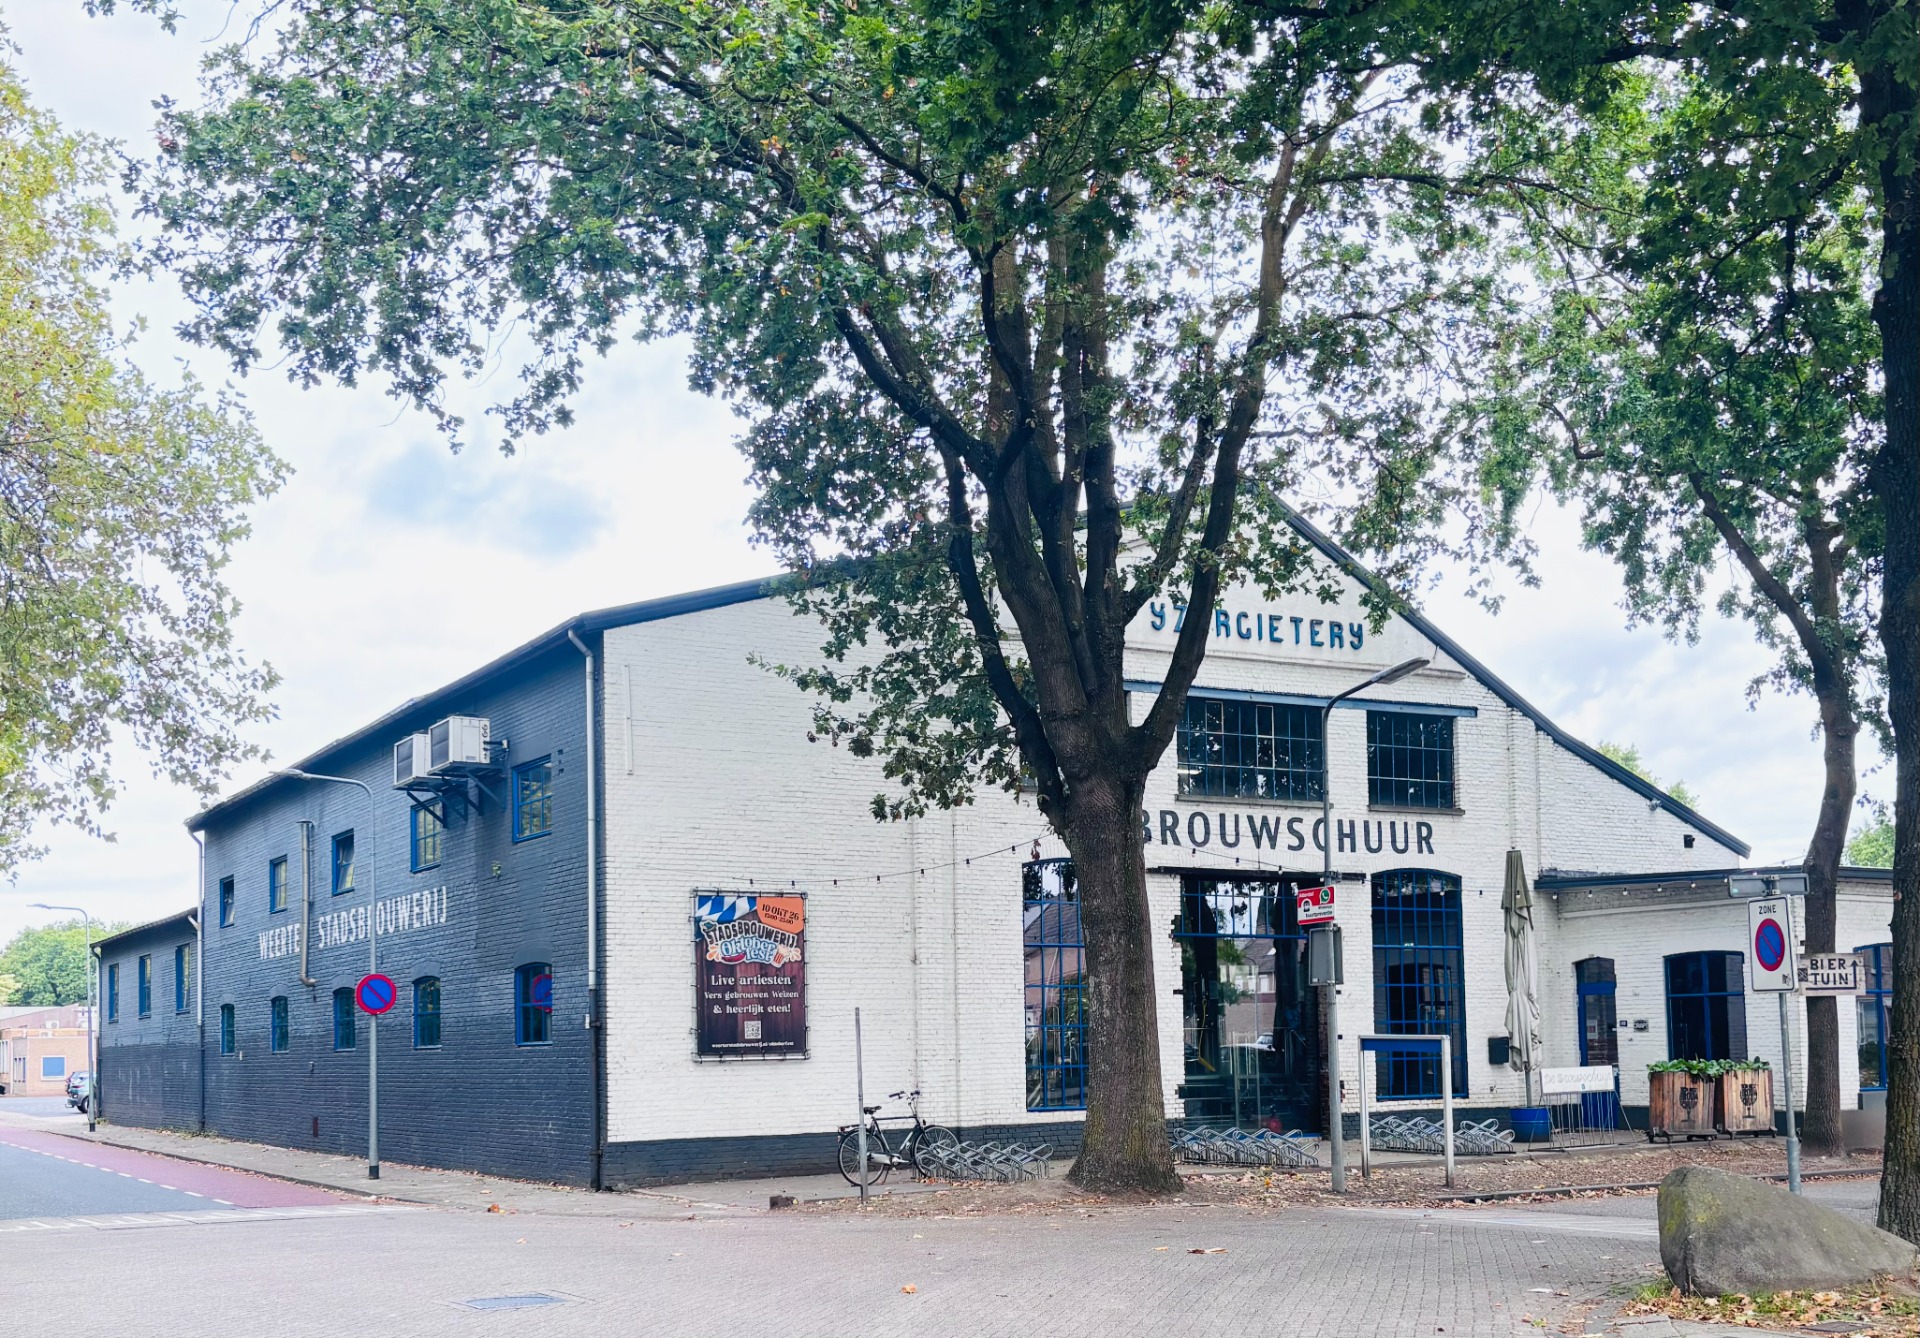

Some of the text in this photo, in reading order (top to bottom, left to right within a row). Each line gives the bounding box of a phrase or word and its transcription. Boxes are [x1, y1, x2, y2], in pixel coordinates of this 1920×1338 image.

[1150, 601, 1364, 650] YZRGIETERY
[762, 904, 771, 912] 10
[789, 911, 800, 920] 26
[1758, 904, 1777, 915] ZONE
[258, 923, 302, 960] WEERTE
[706, 921, 796, 948] STADSBROUWERIJ
[721, 937, 775, 956] Oktober
[745, 947, 772, 961] fest
[1809, 958, 1847, 971] BIER
[711, 975, 792, 986] Live artiesten
[1810, 972, 1849, 986] TUIN
[704, 990, 799, 1001] Vers gebrouwen Weizen
[713, 1003, 791, 1015] & heerlijk eten!
